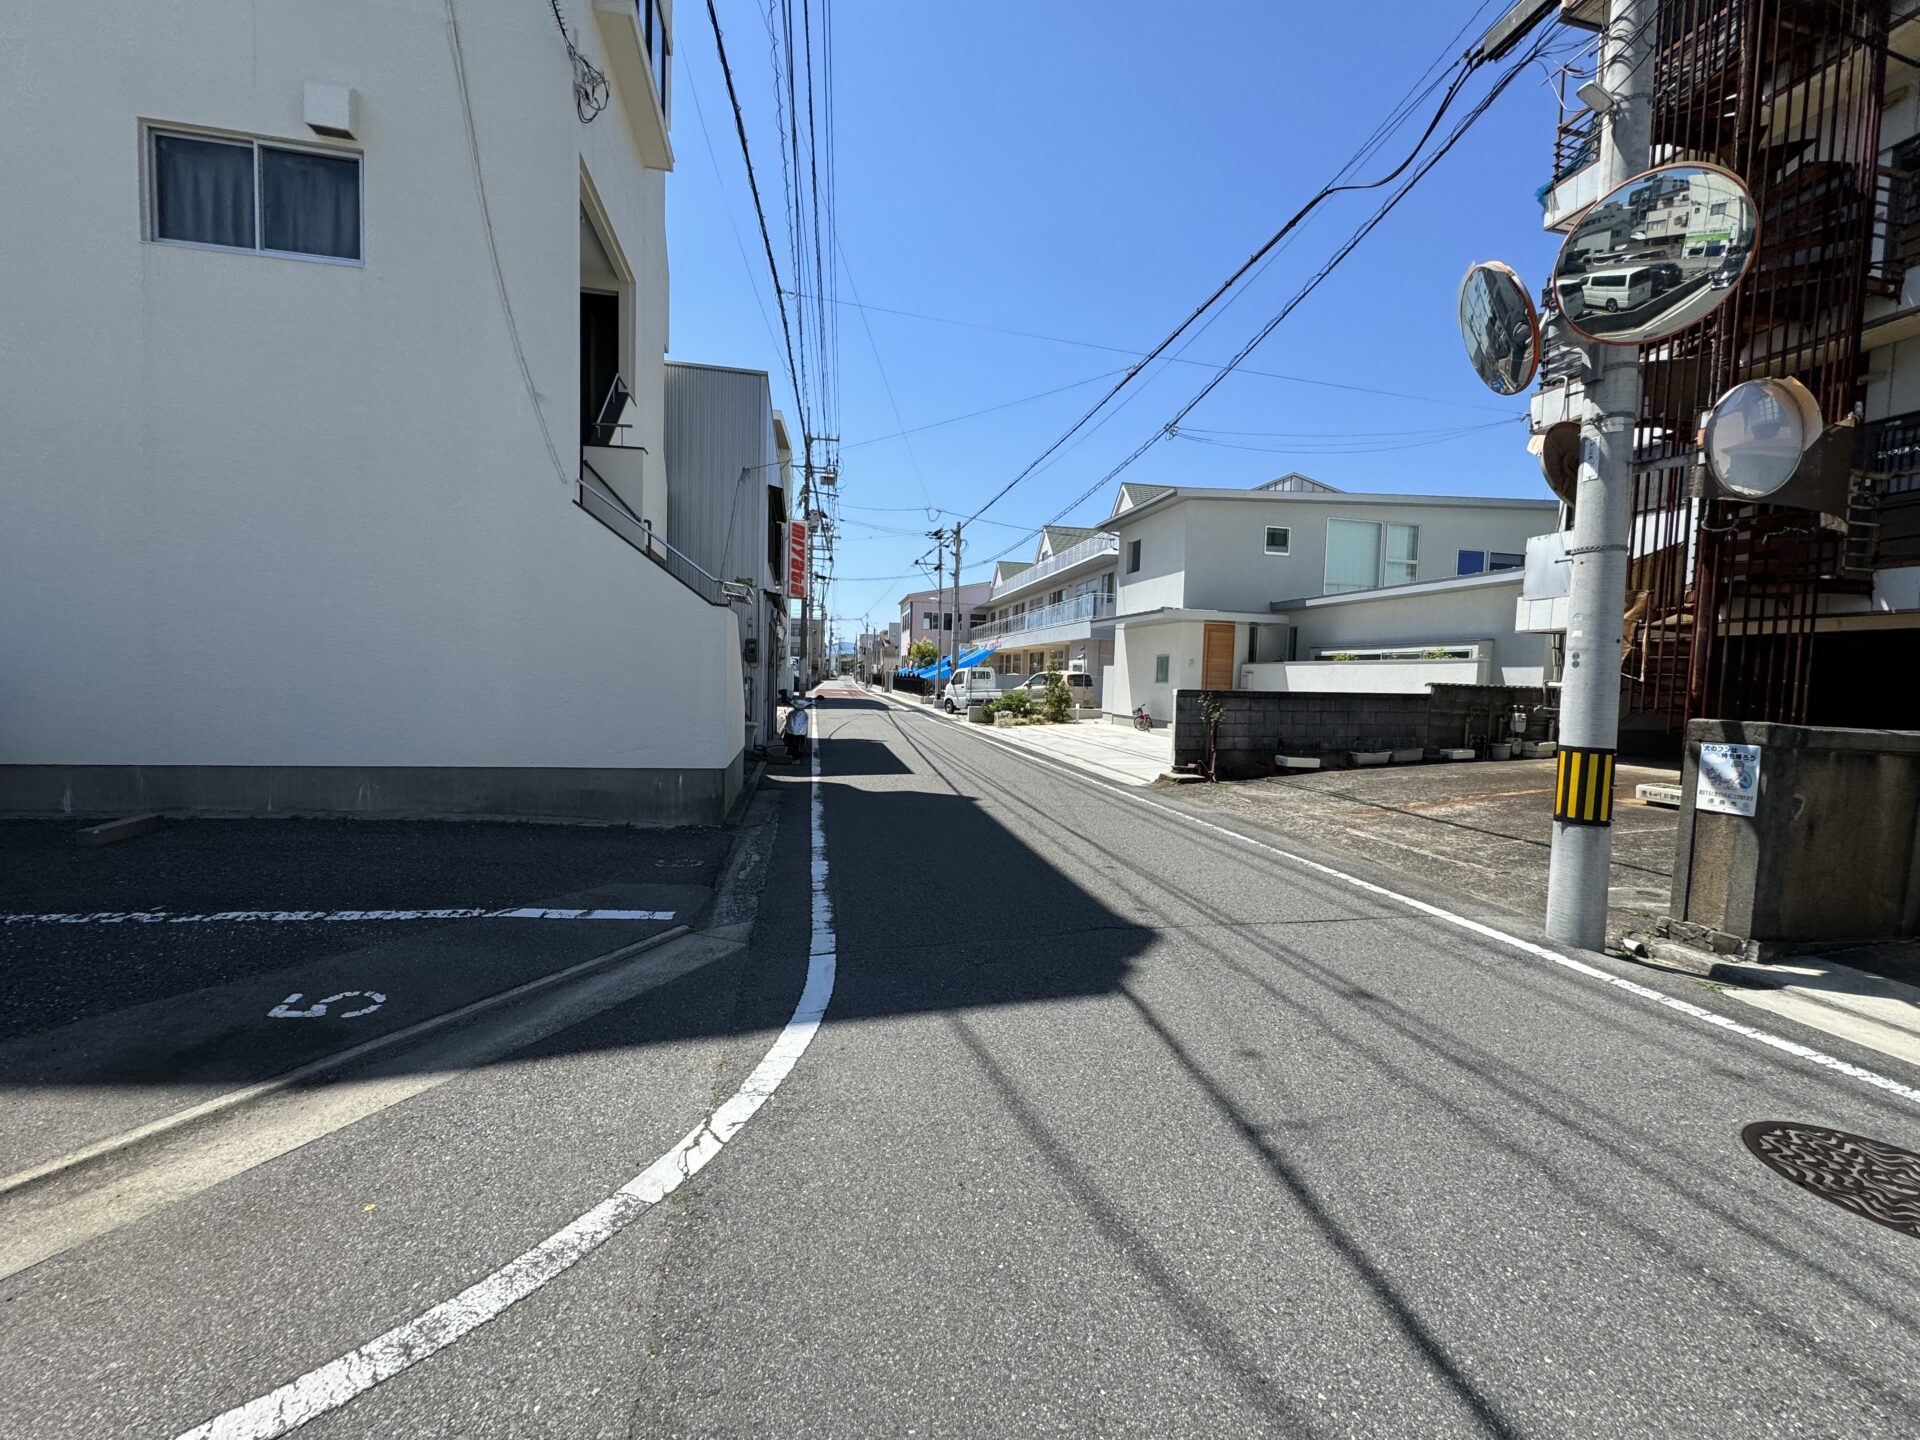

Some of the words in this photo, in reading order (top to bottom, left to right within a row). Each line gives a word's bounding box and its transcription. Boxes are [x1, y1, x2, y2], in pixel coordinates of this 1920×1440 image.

[1703, 745, 1738, 754] 犬のフンは
[1721, 752, 1756, 762] 持ち帰ろう
[267, 991, 386, 1018] 5
